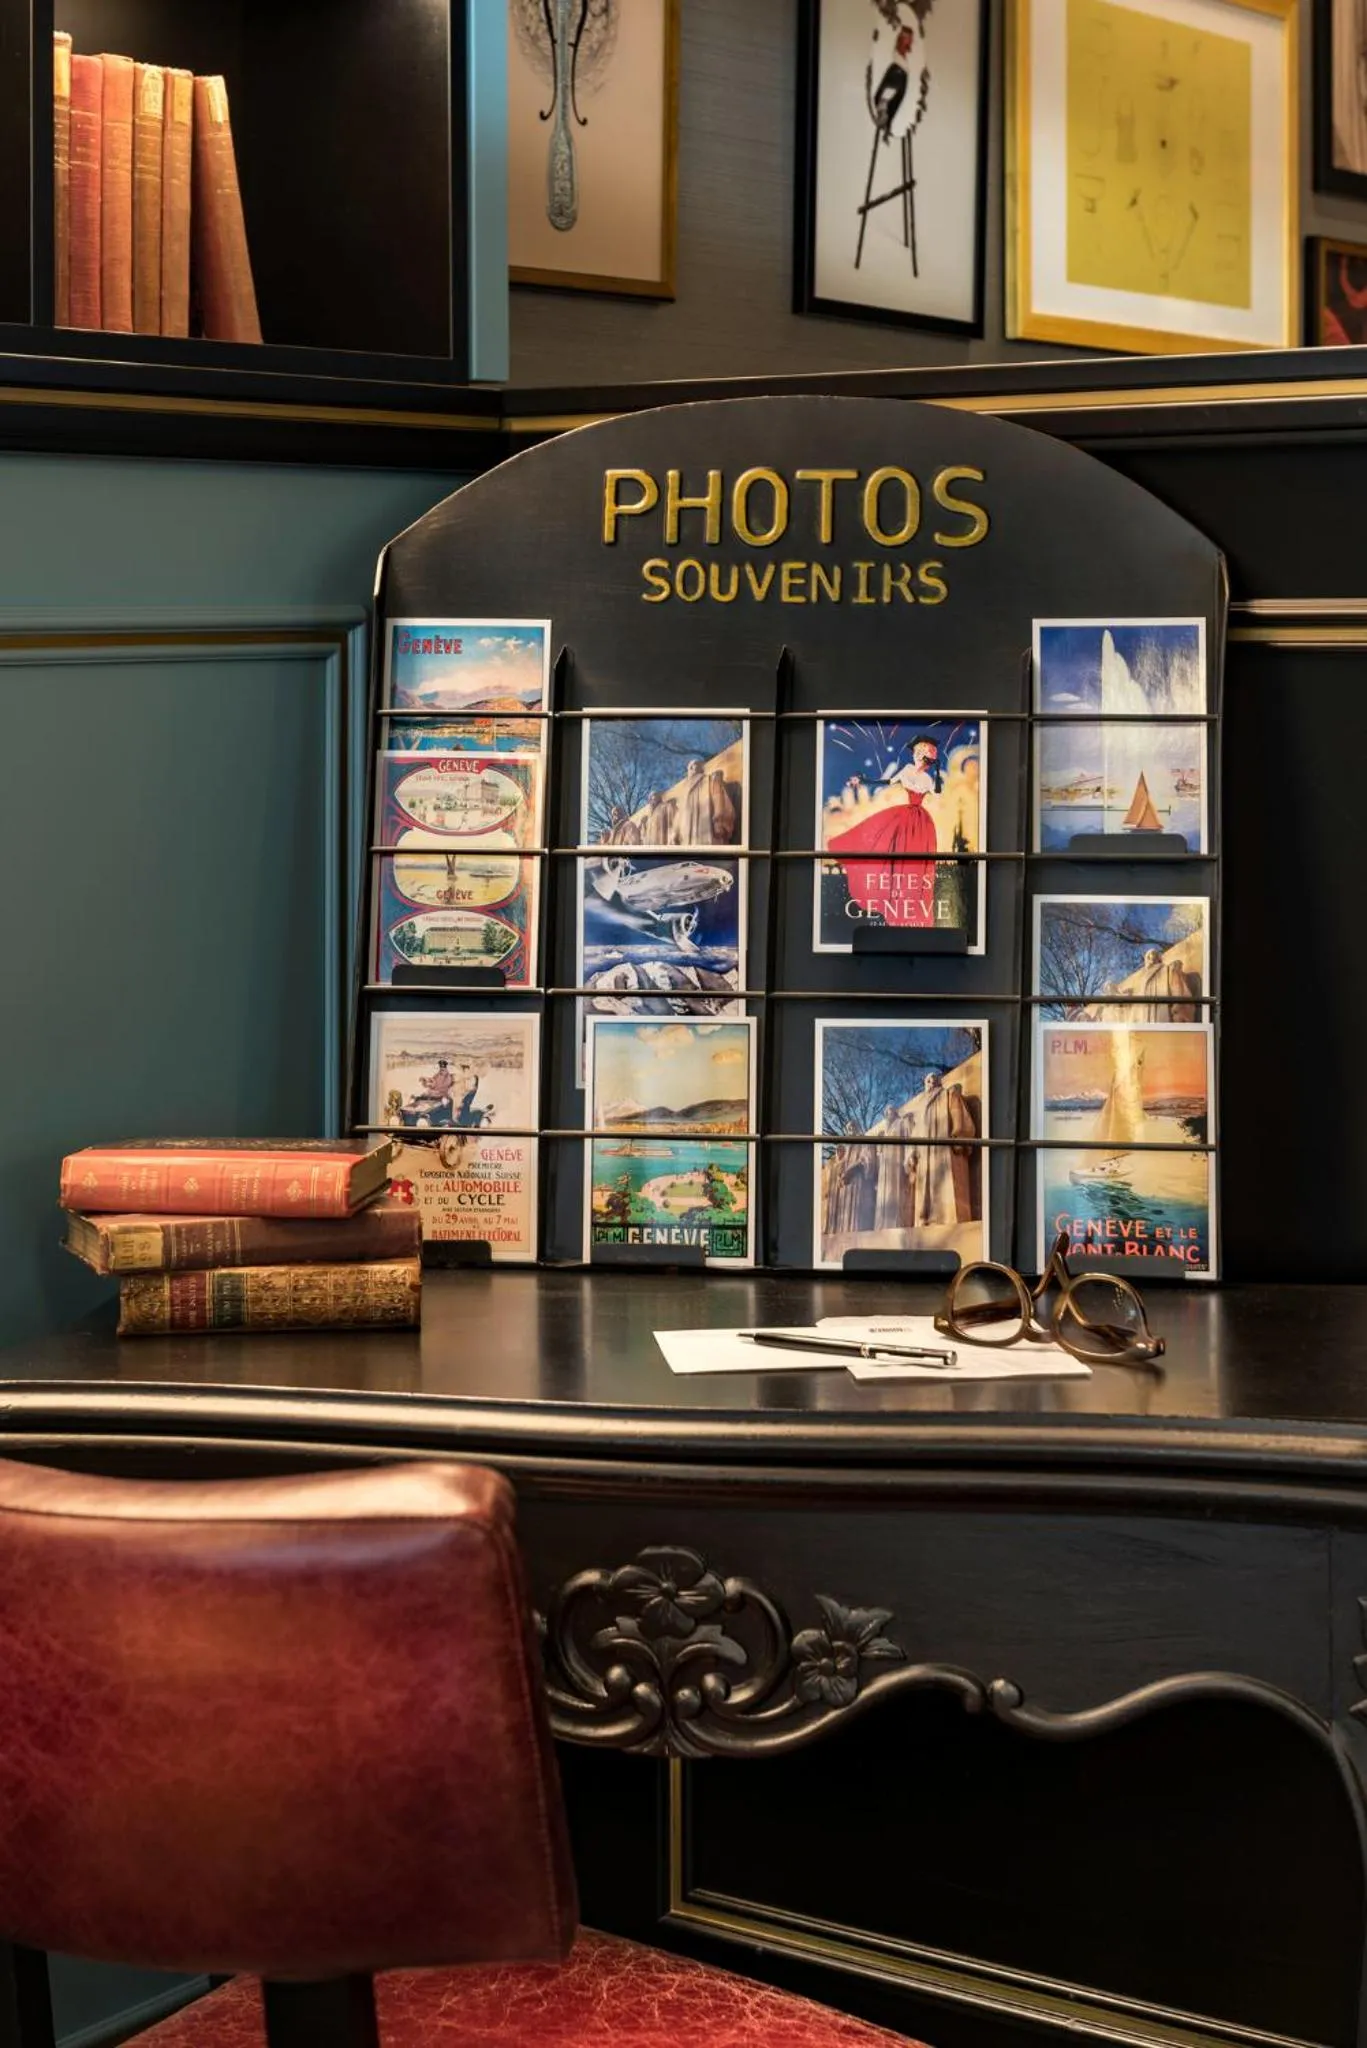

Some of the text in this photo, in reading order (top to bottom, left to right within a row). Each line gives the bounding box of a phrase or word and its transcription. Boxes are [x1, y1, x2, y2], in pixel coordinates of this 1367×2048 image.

[603, 466, 990, 547] PHOTOS
[641, 557, 948, 604] SOUVENIRS
[438, 1197, 449, 1205] DU
[457, 1193, 506, 1206] CYCLE
[445, 1213, 458, 1225] 29
[1156, 1226, 1173, 1238] ET
[1180, 1227, 1199, 1239] LE
[1066, 1241, 1200, 1263] ONT-BLANC
